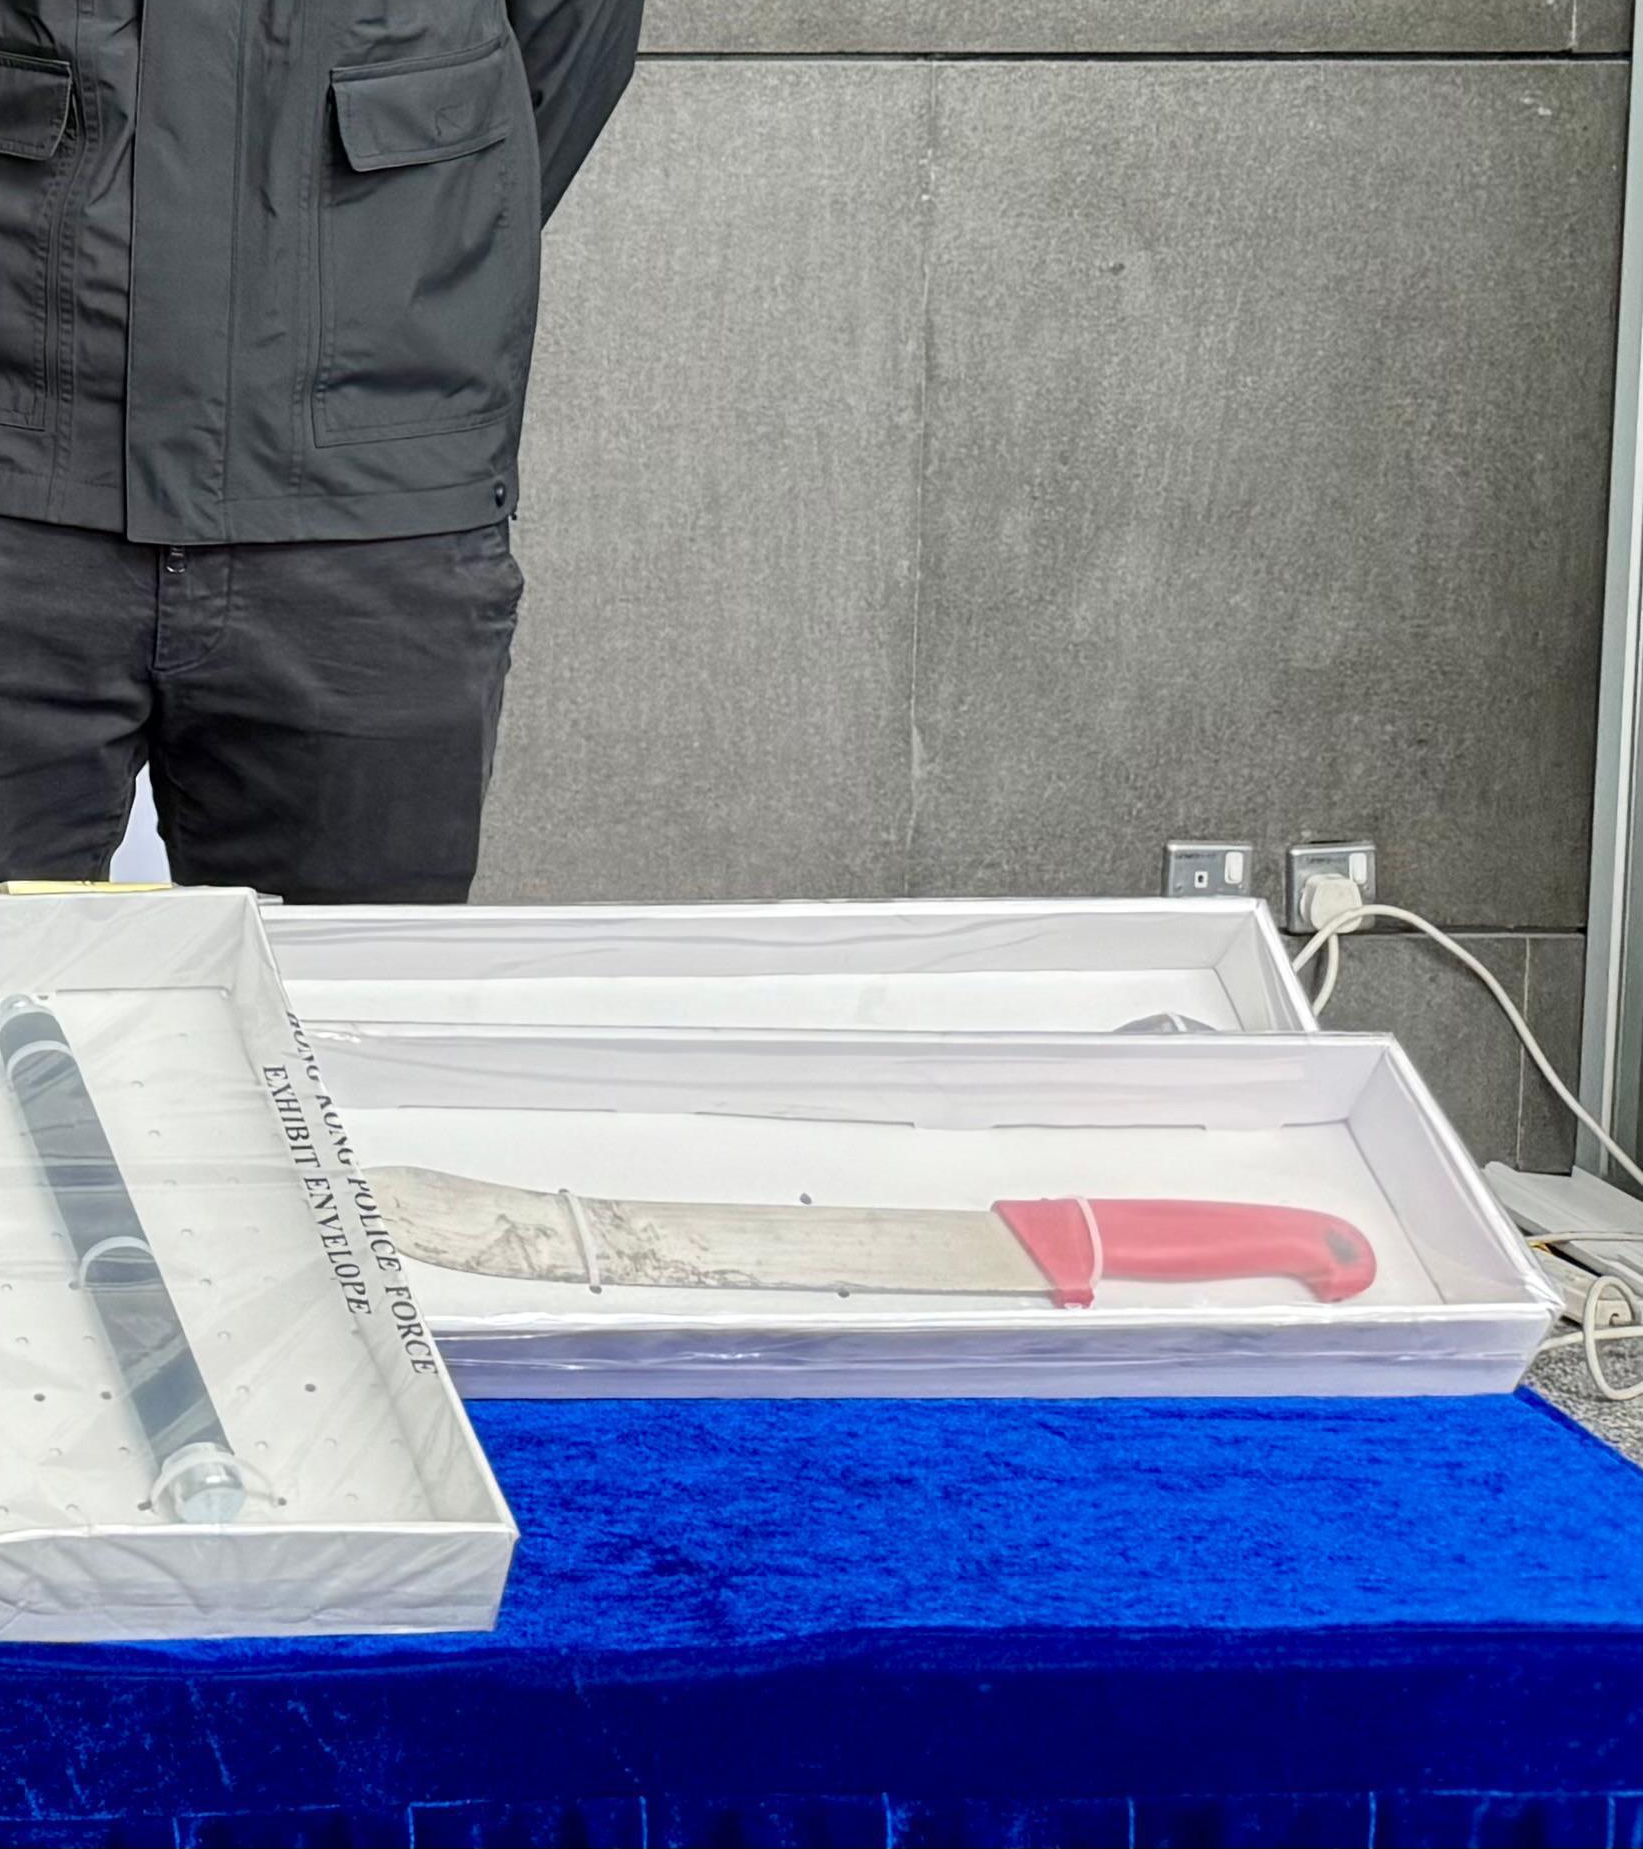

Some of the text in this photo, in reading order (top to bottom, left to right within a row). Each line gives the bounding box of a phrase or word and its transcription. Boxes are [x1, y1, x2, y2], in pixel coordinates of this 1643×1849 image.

[263, 1064, 374, 1316] EXHIBIT ENVELOPE
[347, 1175, 403, 1274] POLICE
[384, 1284, 440, 1376] FORCE
